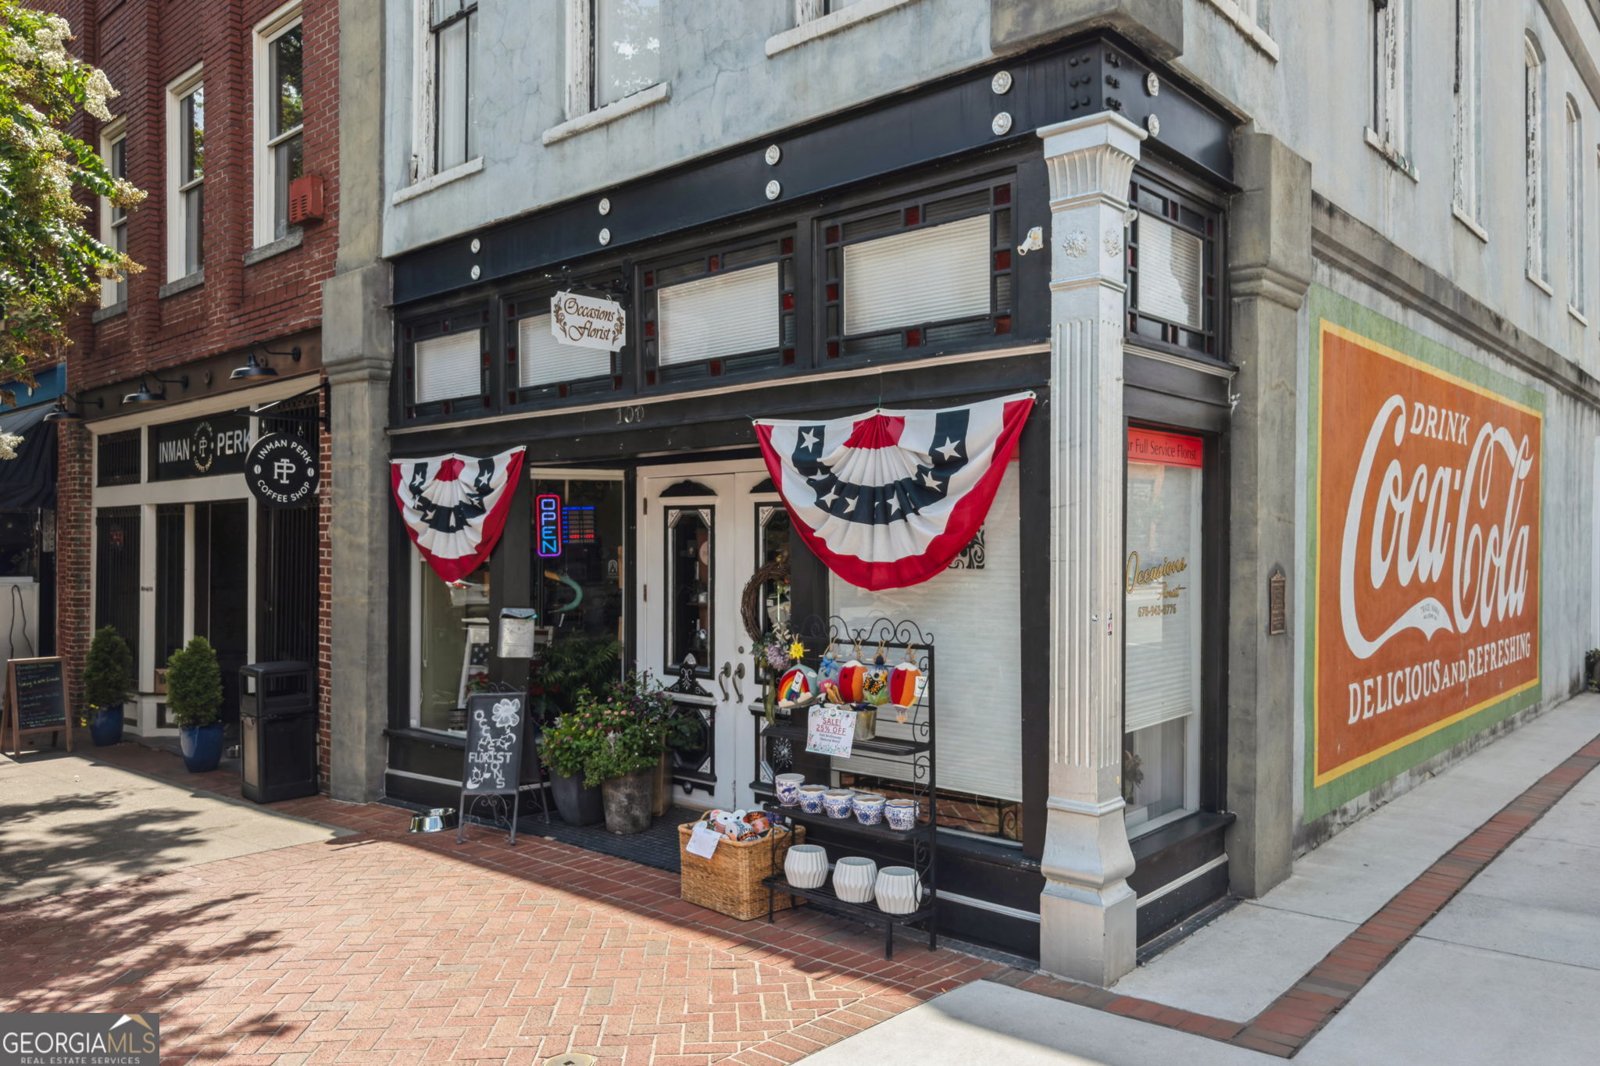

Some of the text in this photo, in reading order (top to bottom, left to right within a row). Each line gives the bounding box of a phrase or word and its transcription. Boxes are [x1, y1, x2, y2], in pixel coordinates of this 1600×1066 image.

[564, 297, 615, 322] Occasions
[568, 320, 611, 341] Florist
[1410, 401, 1470, 446] DRINK
[159, 438, 190, 464] INMAN
[257, 439, 313, 464] INMAN PERK
[1135, 438, 1148, 454] Full
[1150, 440, 1175, 457] Service
[257, 479, 311, 503] COFFEE SHOP
[541, 498, 557, 554] OPEN
[1348, 632, 1531, 725] DELICIOUS AND REFRESHING
[816, 724, 830, 733] 25%
[833, 726, 847, 736] OFF
[822, 717, 842, 727] SALE!
[468, 751, 513, 764] FLORIST
